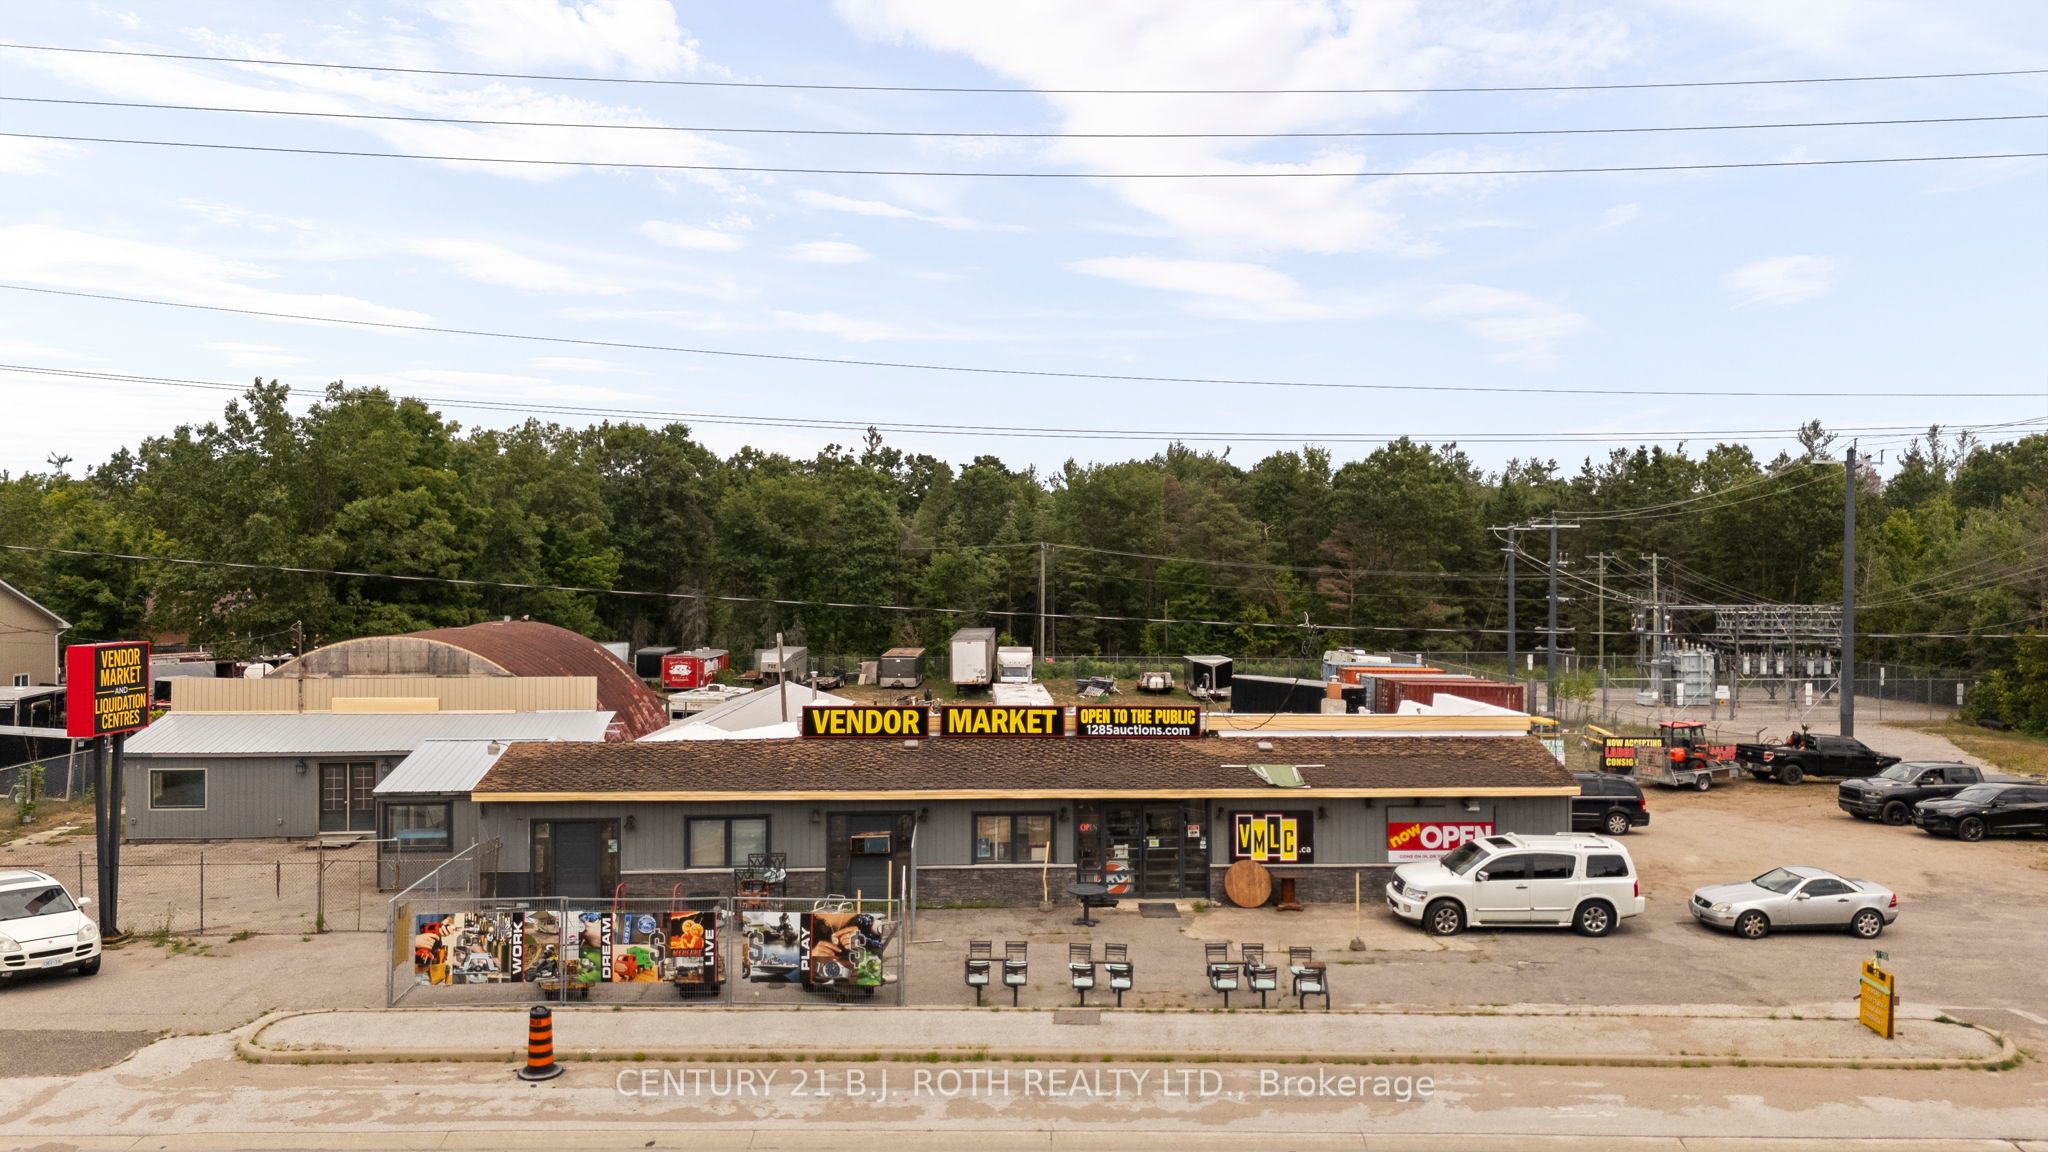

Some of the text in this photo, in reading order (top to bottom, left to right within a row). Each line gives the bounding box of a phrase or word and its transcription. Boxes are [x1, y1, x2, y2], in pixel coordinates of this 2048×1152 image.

[101, 648, 141, 668] VENDOR
[101, 666, 141, 687] MARKET
[115, 687, 129, 695] AND
[95, 693, 146, 714] LIQUIDATION
[101, 709, 140, 729] CENTRES
[812, 709, 919, 734] VENDOR
[949, 709, 1057, 734] MARKET
[1080, 709, 1196, 725] OPEN TO THE PUBLIC
[1086, 725, 1190, 736] 1285auctions.com
[1606, 739, 1662, 747] NOW ACCEPTING
[1389, 823, 1421, 849] now
[511, 920, 524, 974] WORK
[601, 917, 612, 979] DREAM
[704, 929, 715, 966] LIVE
[800, 927, 811, 971] PLAY
